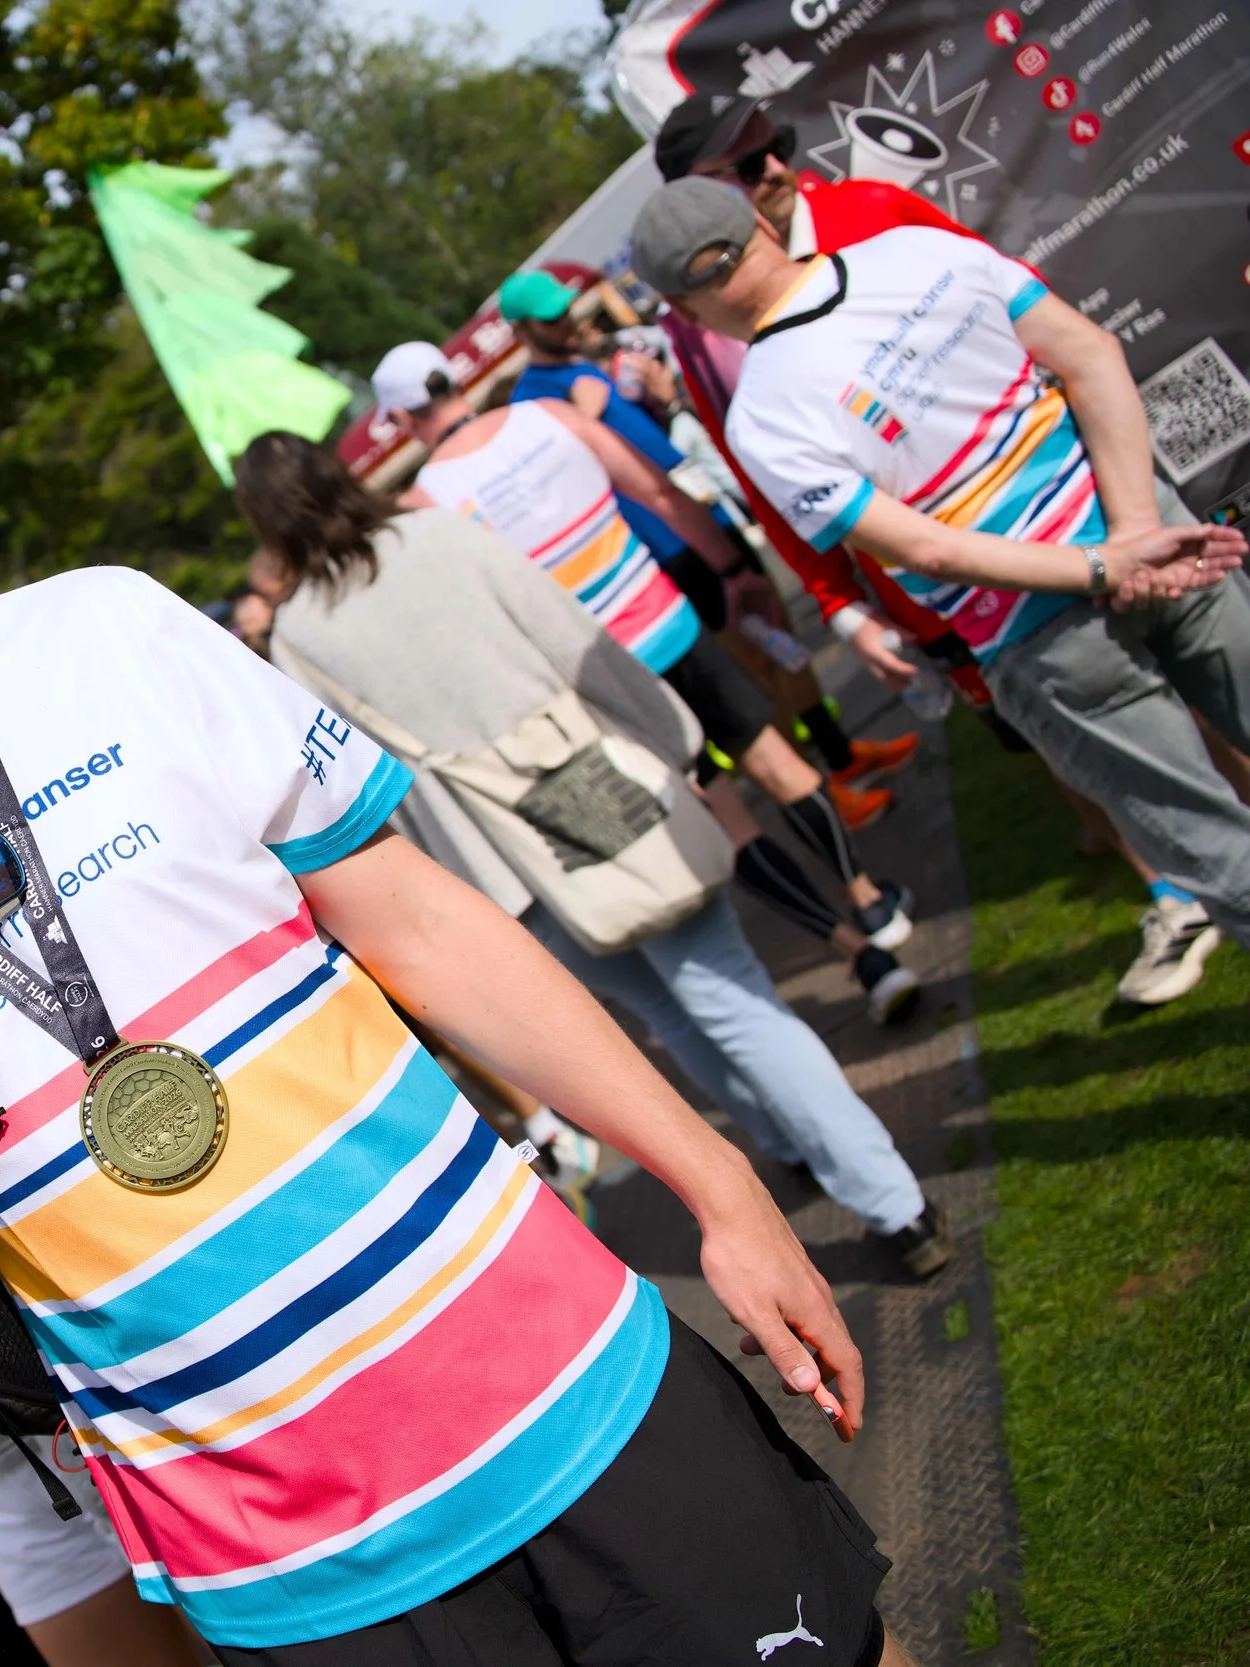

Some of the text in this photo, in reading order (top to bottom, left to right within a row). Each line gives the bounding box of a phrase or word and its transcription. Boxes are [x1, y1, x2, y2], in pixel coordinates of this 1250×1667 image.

[815, 0, 888, 56] HANNE
[1165, 11, 1230, 64] Marathon
[1023, 133, 1190, 265] alfmarathon.co.uk
[301, 708, 352, 786] #TE
[22, 743, 124, 821] anser
[21, 996, 53, 1024] CAERDYDD
[25, 981, 63, 1013] HALF
